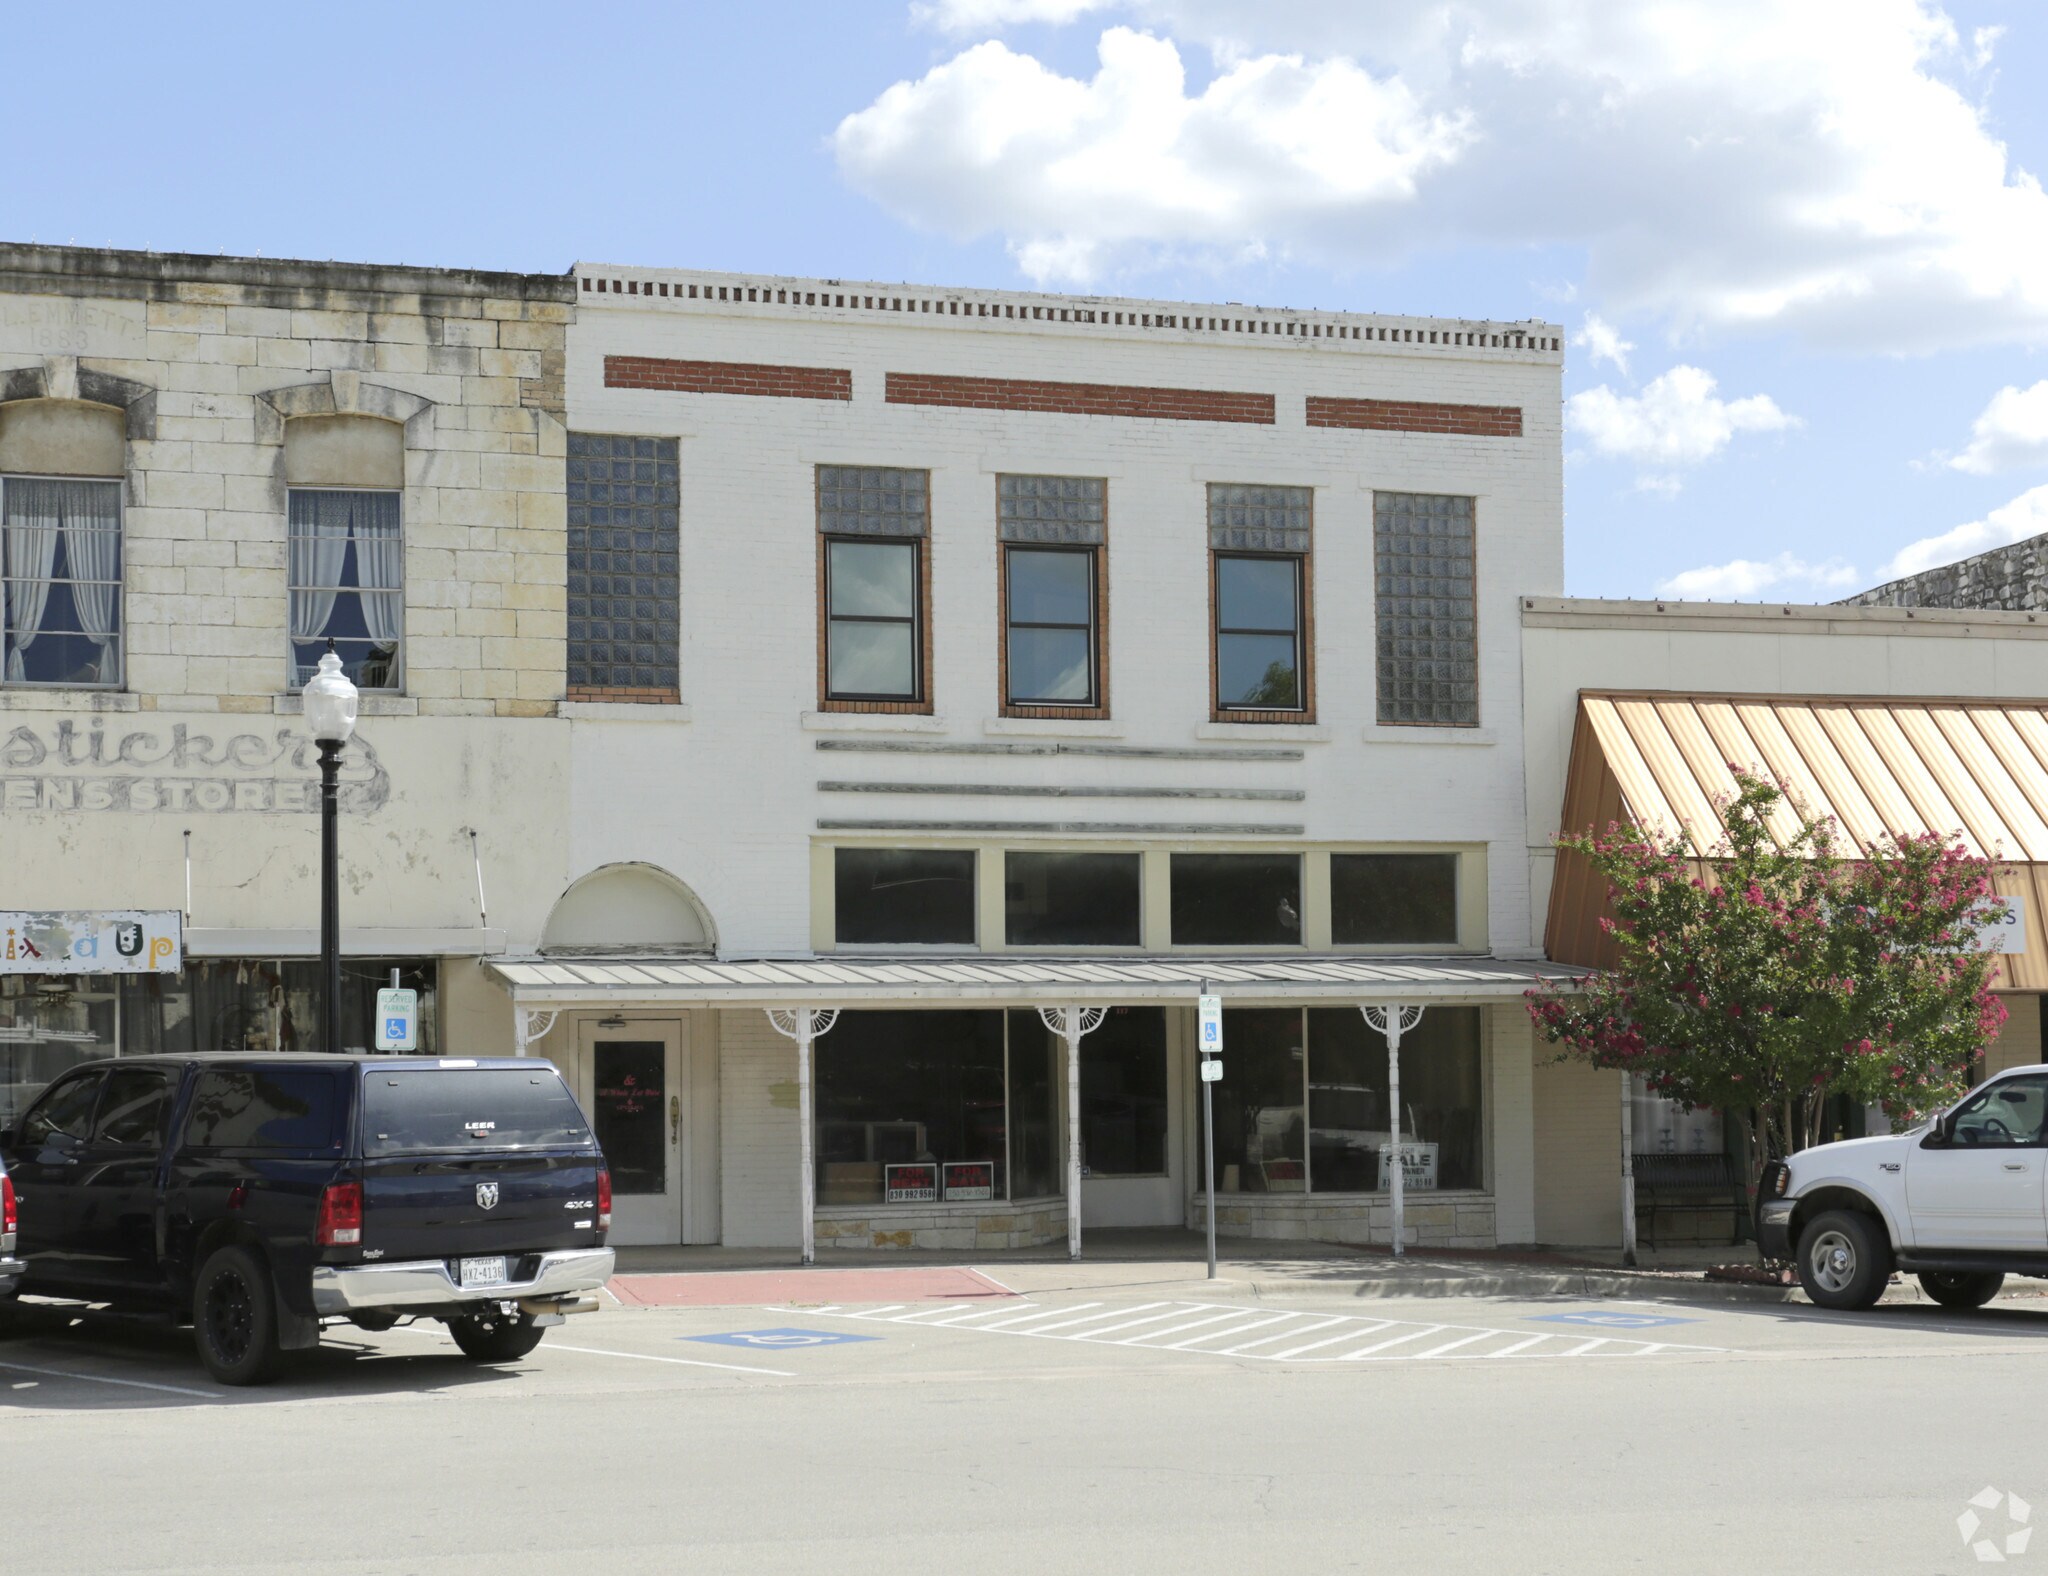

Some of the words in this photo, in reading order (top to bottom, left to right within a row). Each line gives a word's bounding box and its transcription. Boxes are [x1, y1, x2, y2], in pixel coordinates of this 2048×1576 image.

[128, 777, 306, 811] STORE
[383, 1004, 410, 1012] PARKING
[464, 1121, 496, 1130] LEER
[1385, 1154, 1431, 1167] SALE
[897, 1167, 925, 1177] FOR
[954, 1166, 982, 1176] FOR
[890, 1178, 930, 1188] RENT
[947, 1177, 989, 1187] SALE
[889, 1190, 903, 1200] 830
[904, 1190, 919, 1199] 992
[563, 1200, 594, 1210] 4X4
